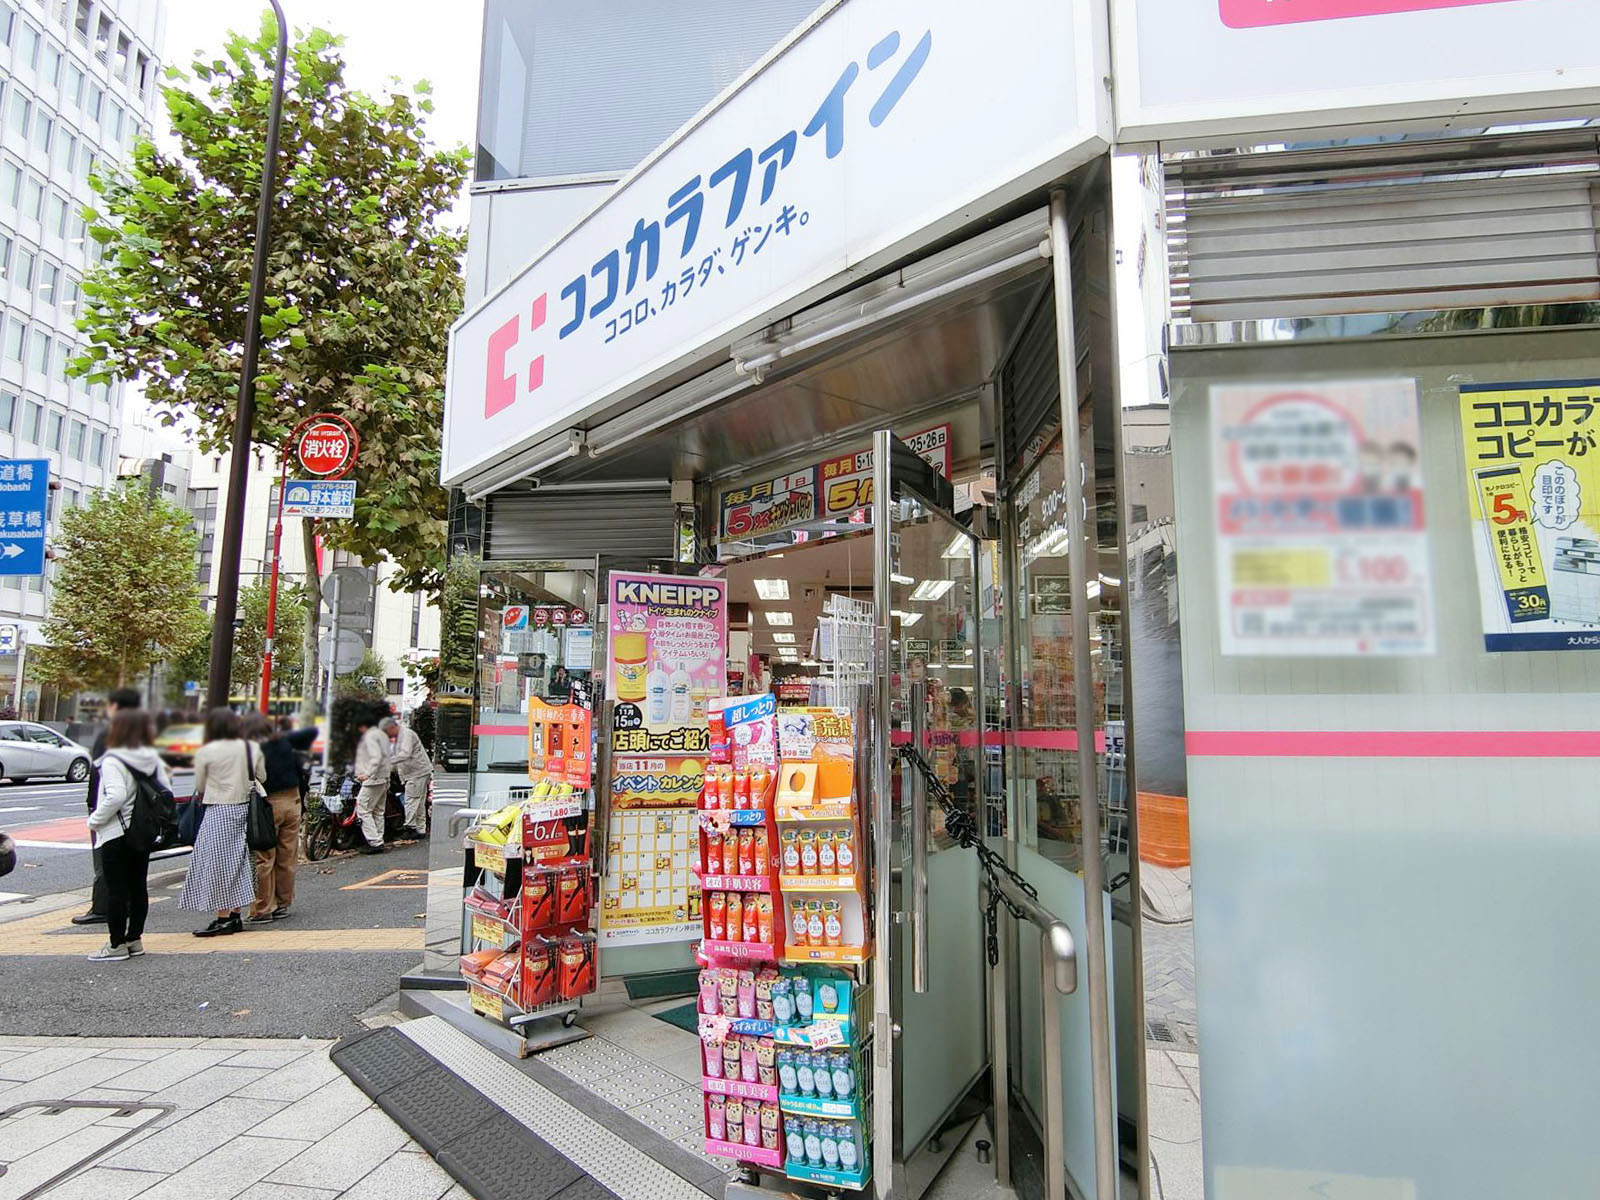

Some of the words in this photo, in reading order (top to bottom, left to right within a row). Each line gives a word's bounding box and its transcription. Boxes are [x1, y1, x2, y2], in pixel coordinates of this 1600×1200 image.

[559, 29, 932, 340] ココカラファイン
[604, 204, 810, 344] ココロ、カラダ、ゲンキ。
[1473, 396, 1600, 428] ココカラ
[304, 440, 345, 458] 消火栓
[1477, 429, 1597, 459] コピーが
[824, 459, 852, 478] 毎月
[310, 490, 353, 506] 野本歯科
[725, 481, 773, 506] 毎月
[783, 476, 806, 491] 1日
[1542, 475, 1553, 514] 目印です
[1492, 493, 1527, 525] 5円
[1519, 526, 1536, 574] 格安コピーで
[617, 581, 720, 607] KNEIPP
[648, 607, 718, 619] ドイツ生まれのクナイプ
[732, 700, 773, 725] 超しっとり
